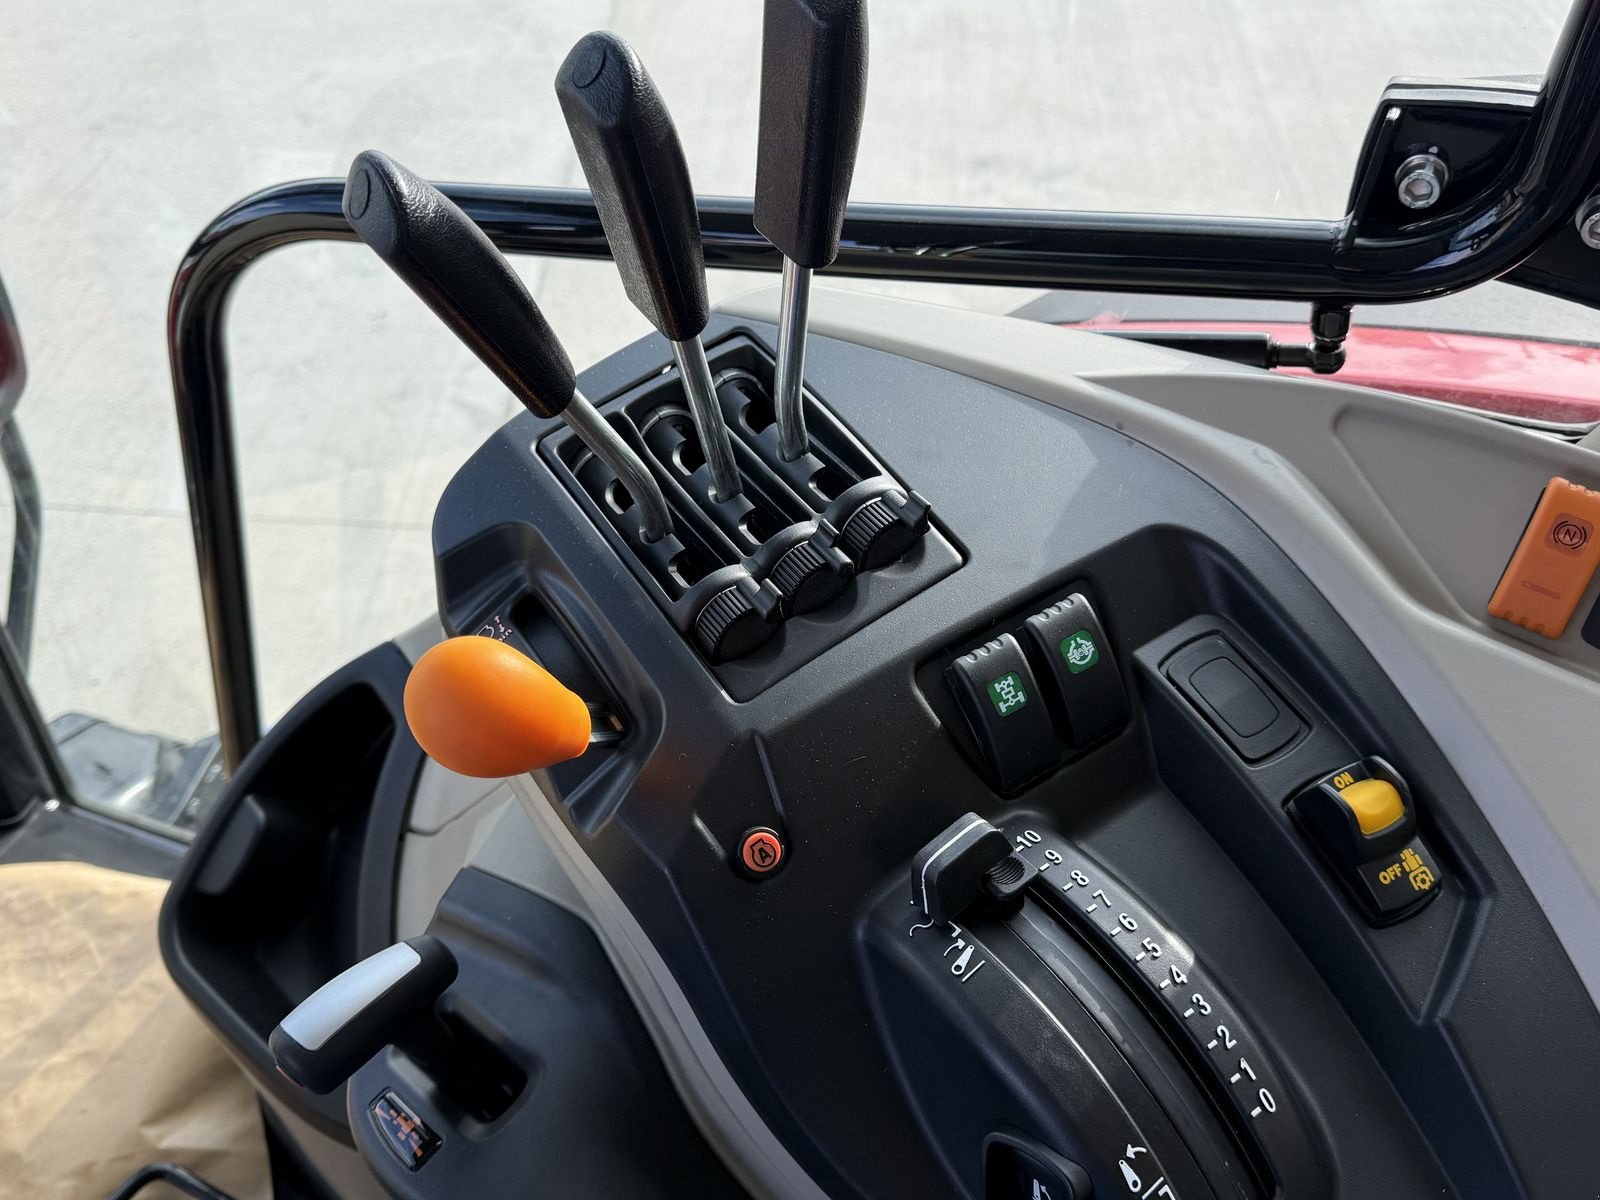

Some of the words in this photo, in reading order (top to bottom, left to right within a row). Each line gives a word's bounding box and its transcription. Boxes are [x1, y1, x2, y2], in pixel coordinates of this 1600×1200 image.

[1333, 771, 1354, 789] ON
[1016, 830, 1041, 848] 10
[1045, 849, 1063, 865] 9
[1071, 869, 1090, 887] 8
[1378, 863, 1402, 885] OFF
[1092, 889, 1111, 906] 7
[1118, 912, 1138, 931] 6
[1142, 936, 1162, 958] 5
[1170, 964, 1188, 985] 4
[1191, 993, 1212, 1016] 3
[1216, 1024, 1238, 1050] 2
[1240, 1056, 1257, 1082] 1
[1258, 1087, 1277, 1113] 0
